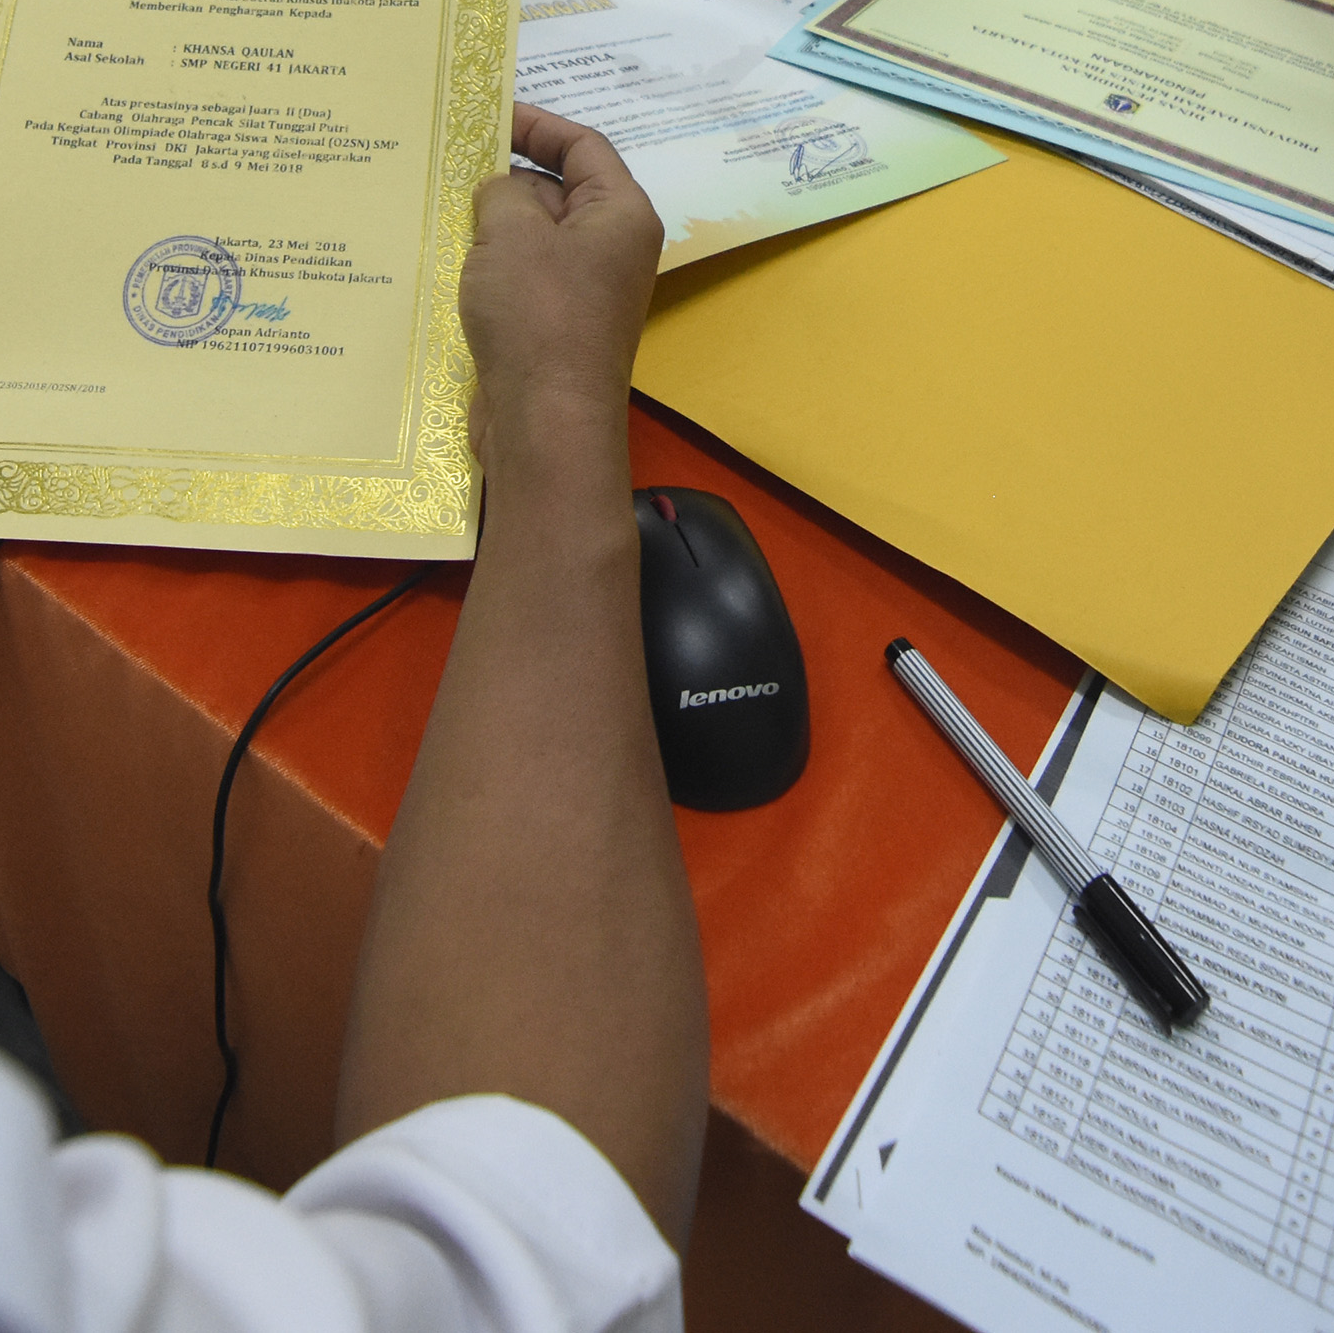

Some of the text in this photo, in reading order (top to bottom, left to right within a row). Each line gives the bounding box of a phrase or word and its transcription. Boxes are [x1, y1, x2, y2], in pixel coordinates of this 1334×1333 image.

[129, 0, 333, 19] Memberikan Penghargaan Kepada
[67, 36, 294, 59] Nama KHANSA QAULAN
[64, 52, 347, 77] Asal Sekolah SMP NEGERI 41 JAKARTA
[547, 52, 616, 71] TSAQYLA
[531, 65, 640, 91] PUTRI TINGKAT SMP
[1090, 52, 1207, 99] PENGHARGAAN
[1061, 64, 1206, 122] DINAS PENDIDIKAN
[79, 109, 349, 133] Cabang Olahraga Pencak Silat Tunggal Putri
[101, 97, 127, 109] Atas
[129, 100, 199, 113] prestasinya
[201, 103, 245, 116] sebagai
[248, 105, 280, 117] Juara
[297, 108, 332, 120] (Dua)
[24, 120, 399, 150] Pada Kegiatan Olimpiade Olahraga Siswa Nasional (O2SN) SMP
[1243, 121, 1319, 153] PROVINSI
[51, 136, 372, 164] Tingkat Provinsi DKI Jakarta yang diselenggarakan
[112, 154, 144, 165] Pada
[147, 156, 192, 170] Tanggal
[234, 160, 242, 170] 9
[247, 162, 269, 172] Mei
[272, 163, 303, 173] 2018
[215, 236, 346, 252] Jakarta, 23 Mei 2018
[200, 250, 352, 267] Kepala Dinas Pendidikan
[148, 262, 200, 275] Provinsi
[250, 267, 294, 279] Khusus
[298, 270, 345, 282] Ibukota
[348, 271, 393, 284] Jakarta
[176, 339, 198, 350] NIP
[214, 326, 310, 340] Sopan Adrianto
[1261, 638, 1327, 674] AZIZAH ISMAN
[1293, 639, 1321, 656] IRFAN
[679, 682, 780, 709] lenovo
[1242, 688, 1319, 729] DIAN SYAHFITRI
[1237, 701, 1282, 727] DIANDRA
[1226, 729, 1269, 755] EUDORA
[1272, 750, 1317, 778] PAULINA
[1176, 741, 1326, 818] 18100 GABRIELA ELEONORA
[1221, 744, 1265, 769] FAATHIR
[1266, 766, 1312, 792] FEBRIAN
[1163, 775, 1280, 840] 18102 HASHIF IRSYAD
[1169, 757, 1322, 838] 18101 HAIKAL ABRAR RAHEN
[1155, 794, 1285, 866] 18103 HASNA HAFIDZAH
